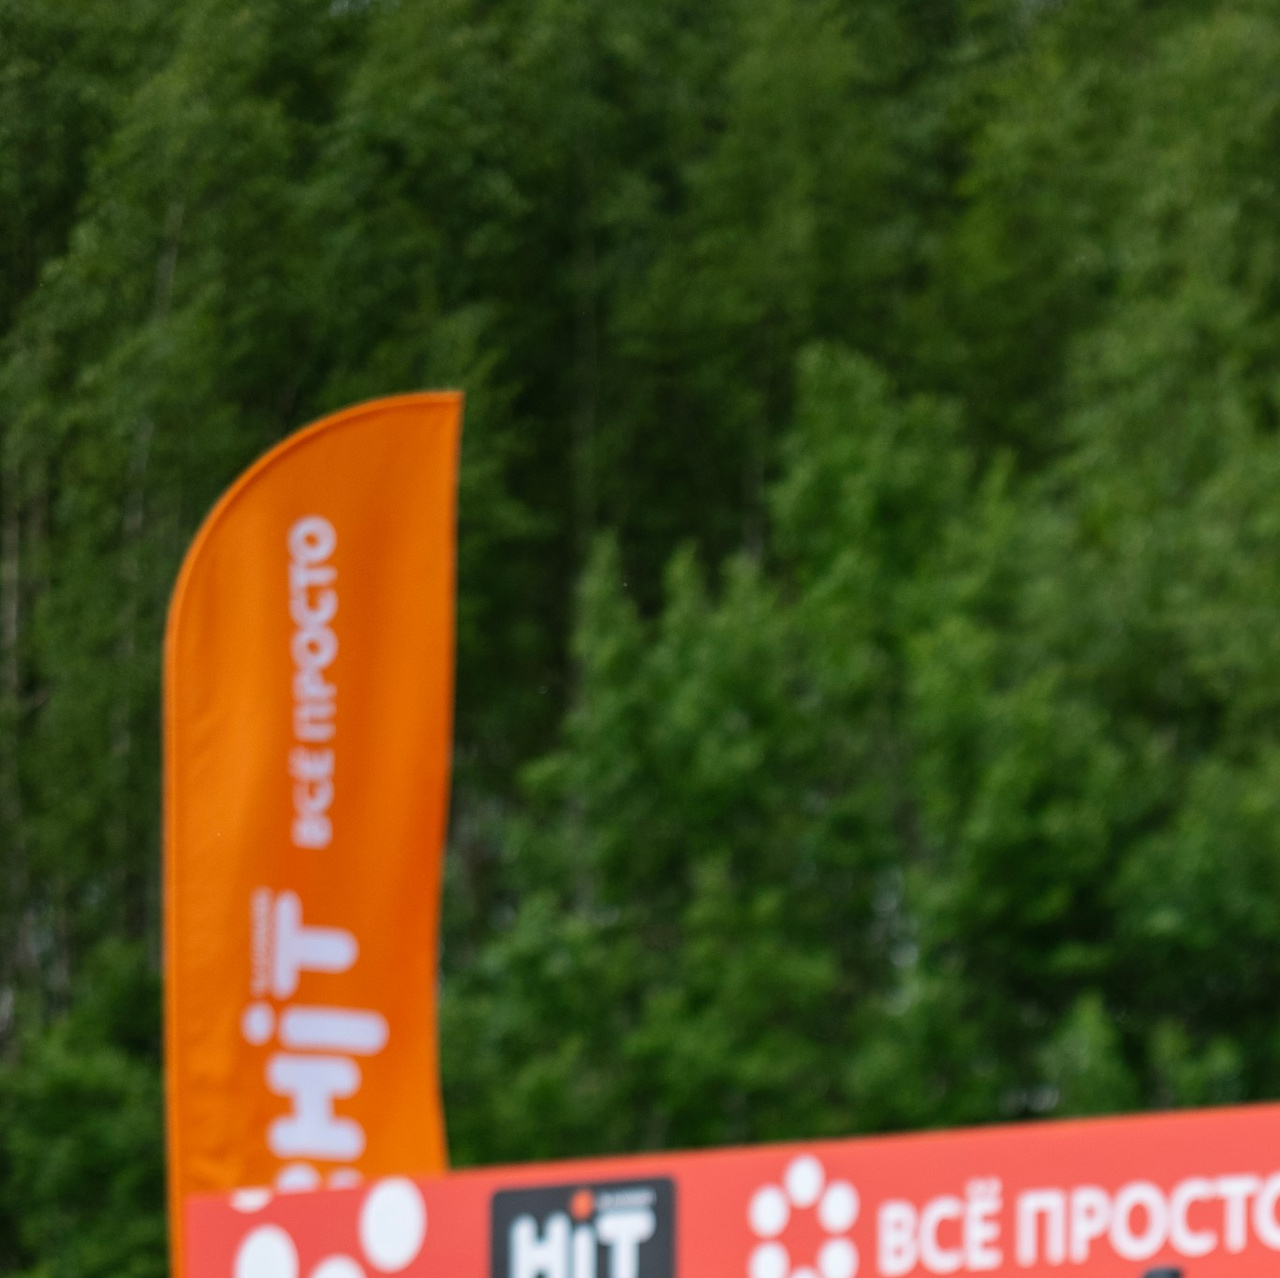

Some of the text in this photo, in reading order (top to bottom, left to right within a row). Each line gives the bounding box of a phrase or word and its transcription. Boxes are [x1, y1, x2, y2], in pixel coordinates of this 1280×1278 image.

[287, 515, 338, 849] ВСЁ ПРОСТО
[877, 1178, 1003, 1277] ВСЁ
